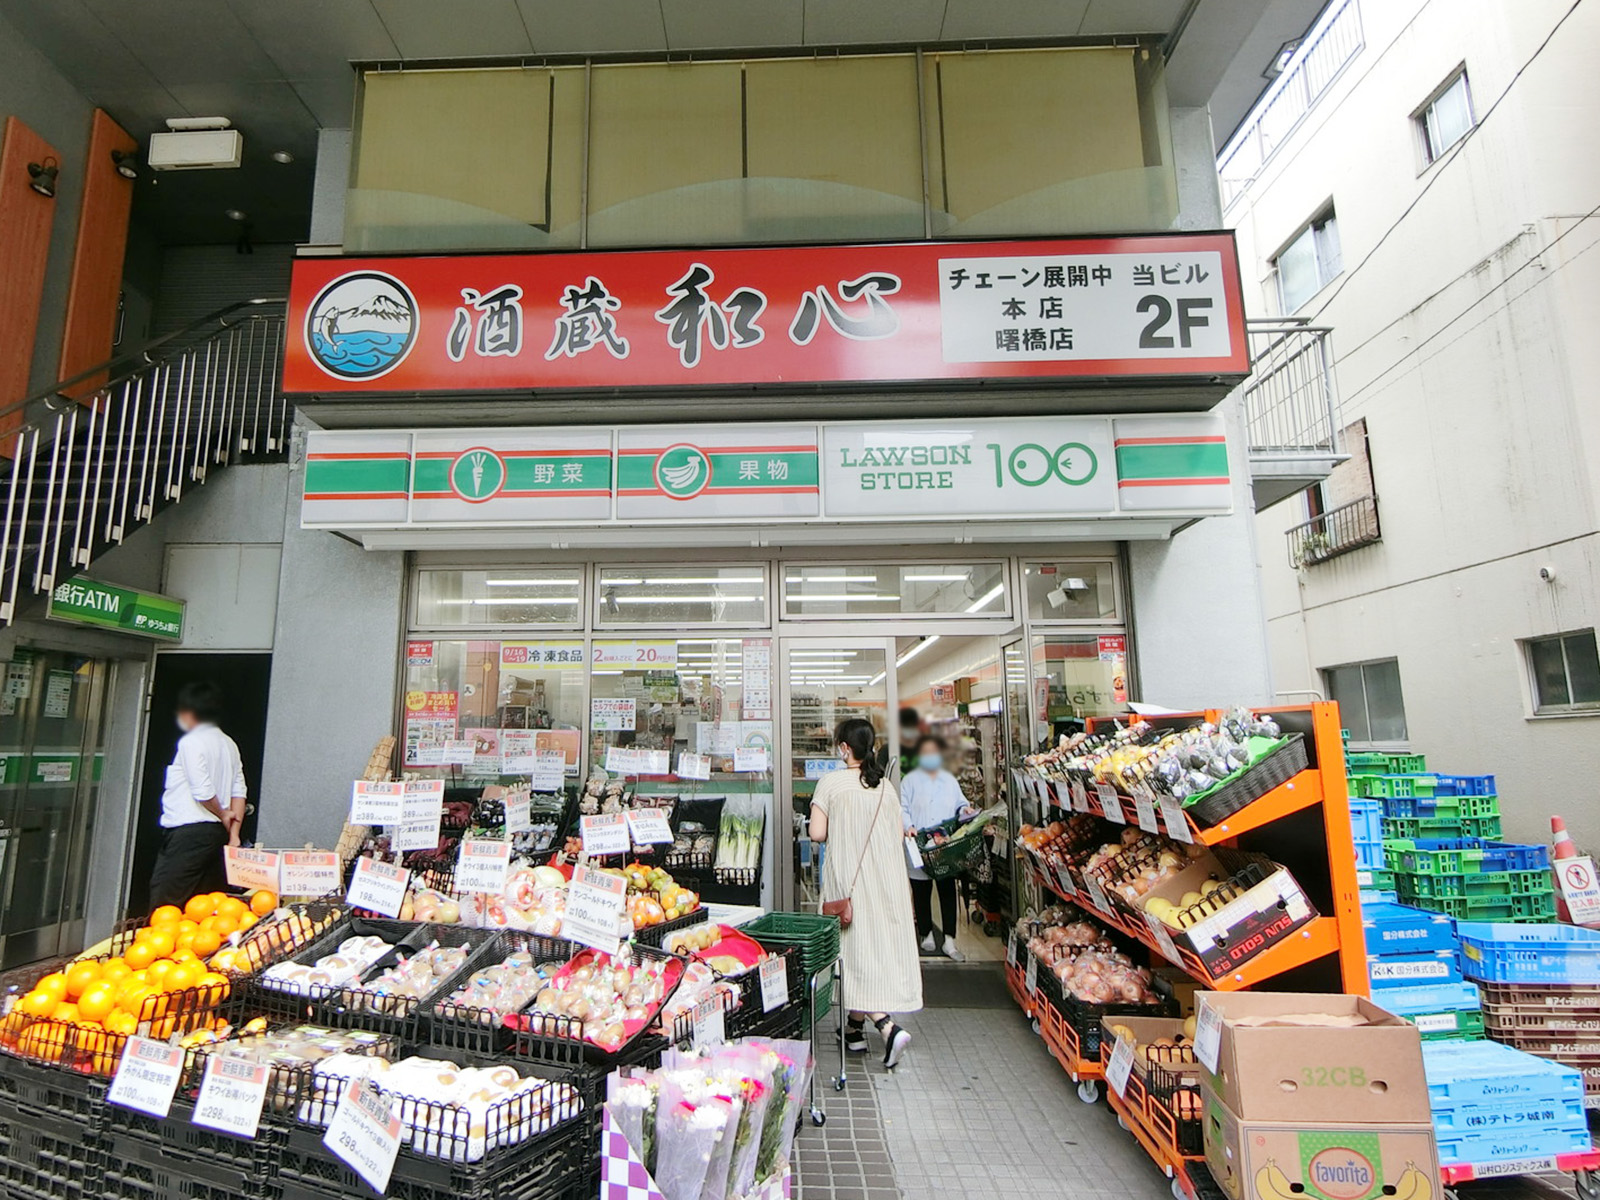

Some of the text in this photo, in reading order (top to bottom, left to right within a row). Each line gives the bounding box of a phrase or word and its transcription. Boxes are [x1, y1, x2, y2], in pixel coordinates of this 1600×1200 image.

[948, 264, 1113, 291] チェーン展開中
[1131, 262, 1210, 287] 当ビル
[447, 263, 902, 369] 酒蔵和心
[1001, 296, 1064, 321] 本店
[1135, 294, 1214, 349] 2F
[994, 327, 1074, 353] 曙橋店
[840, 445, 972, 468] LAWSON
[986, 441, 1098, 488] 100
[533, 463, 584, 485] 野菜
[738, 459, 789, 482] 果物
[860, 471, 954, 490] STORE
[54, 582, 120, 613] 銀行ATM
[147, 619, 180, 634] ゆうちょ銀行
[504, 648, 525, 656] 9/16
[528, 649, 583, 662] 冷凍食品
[1230, 915, 1293, 960] SUN GOLD
[1396, 964, 1446, 976] 国分株式会社
[138, 1042, 171, 1061] 新鮮青果
[124, 1064, 173, 1087] みかん限定特売
[222, 1060, 255, 1079] 新鮮青果
[1300, 1065, 1368, 1087] 32CB
[359, 1090, 391, 1129] 新鮮青果
[1466, 1110, 1555, 1127] (株)テトラ城南
[338, 1131, 358, 1152] 298
[1315, 1161, 1370, 1186] favorita
